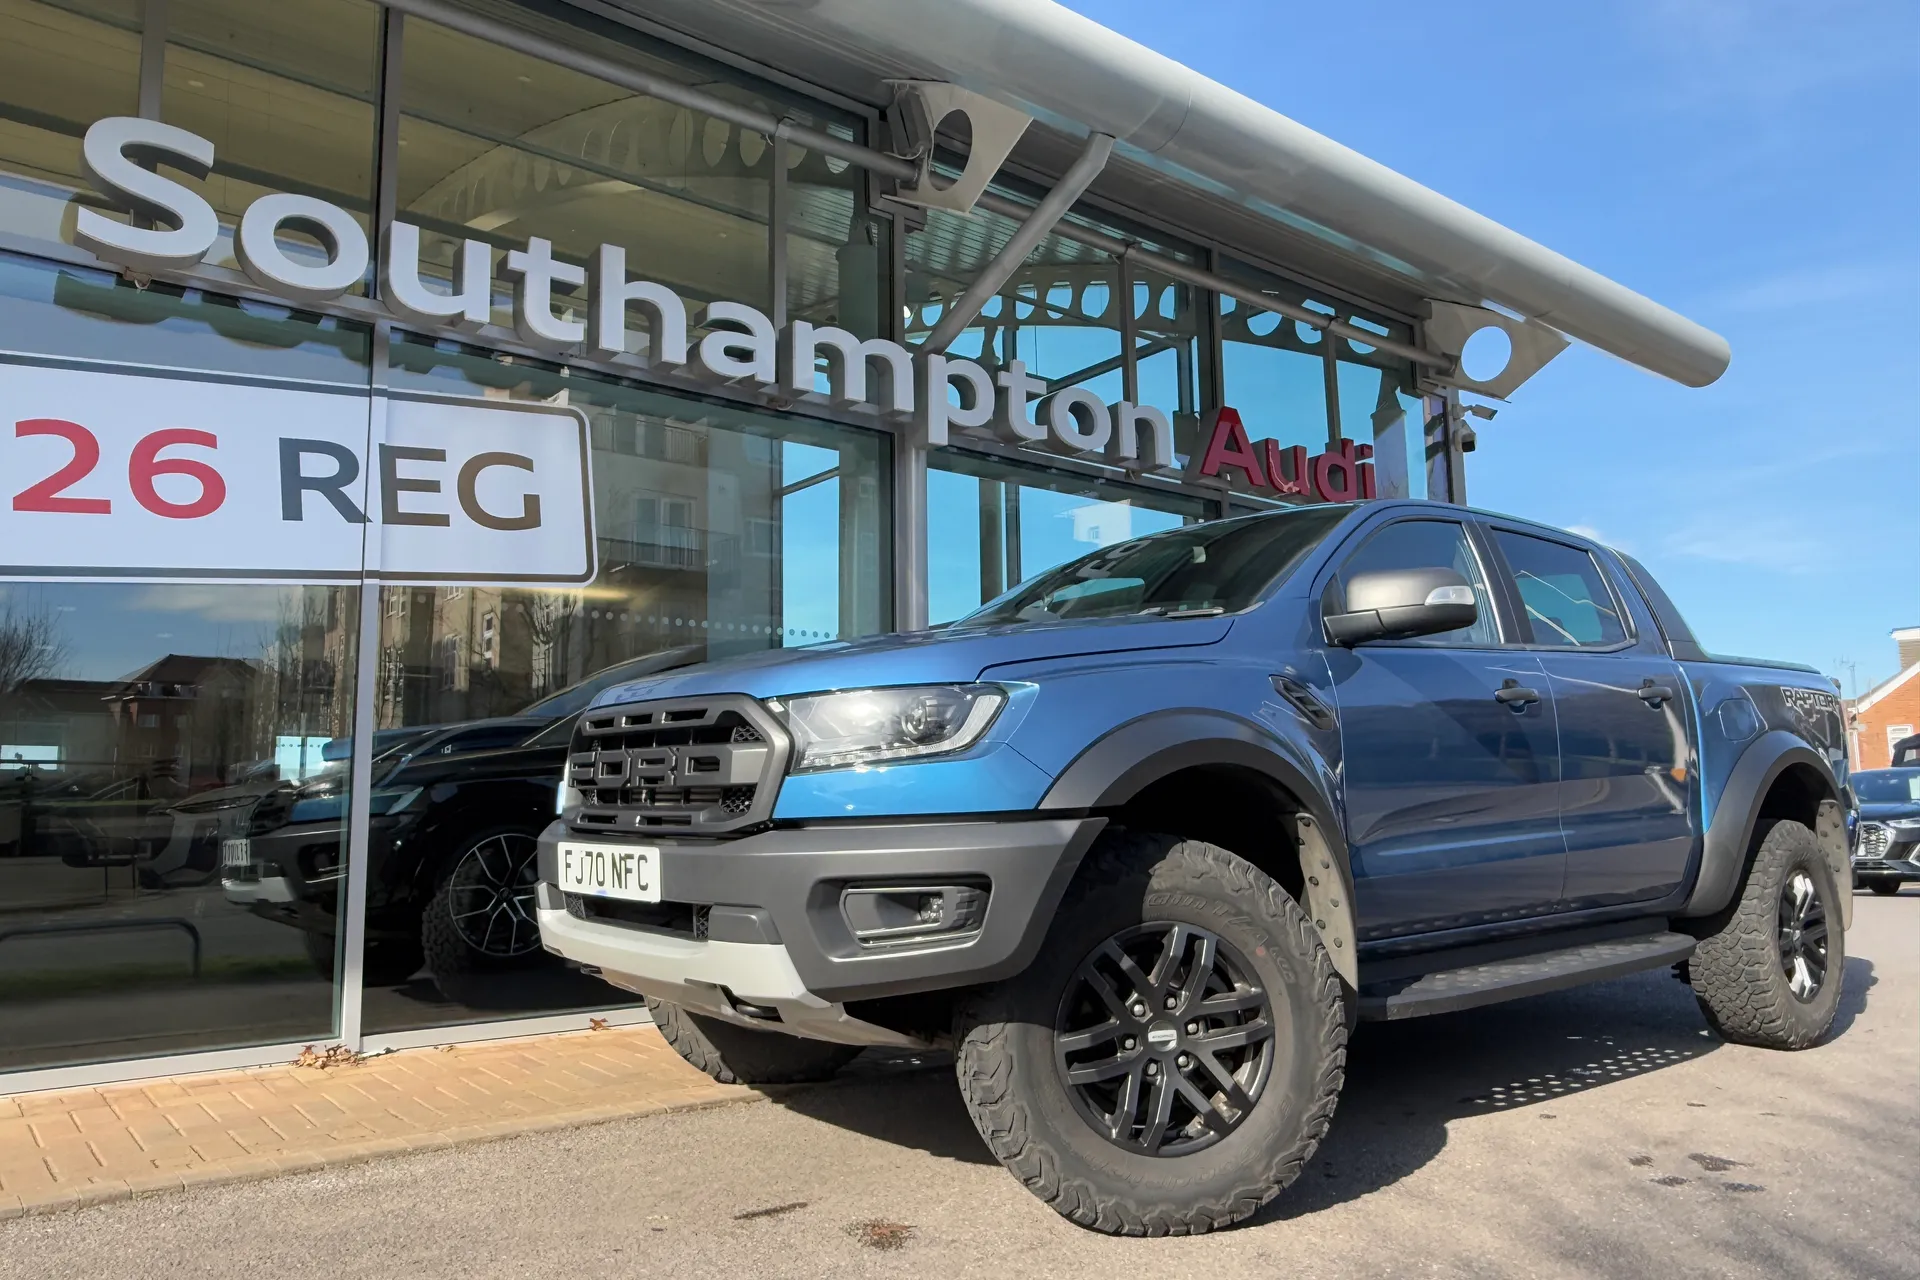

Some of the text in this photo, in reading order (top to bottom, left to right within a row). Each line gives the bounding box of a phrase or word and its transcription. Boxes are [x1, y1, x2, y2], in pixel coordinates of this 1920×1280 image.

[76, 116, 1377, 503] Southampton Audi
[12, 418, 542, 531] 26 REG
[1780, 687, 1836, 712] RAPTOR
[568, 744, 732, 789] FORD
[564, 849, 649, 892] FJ70 NFC
